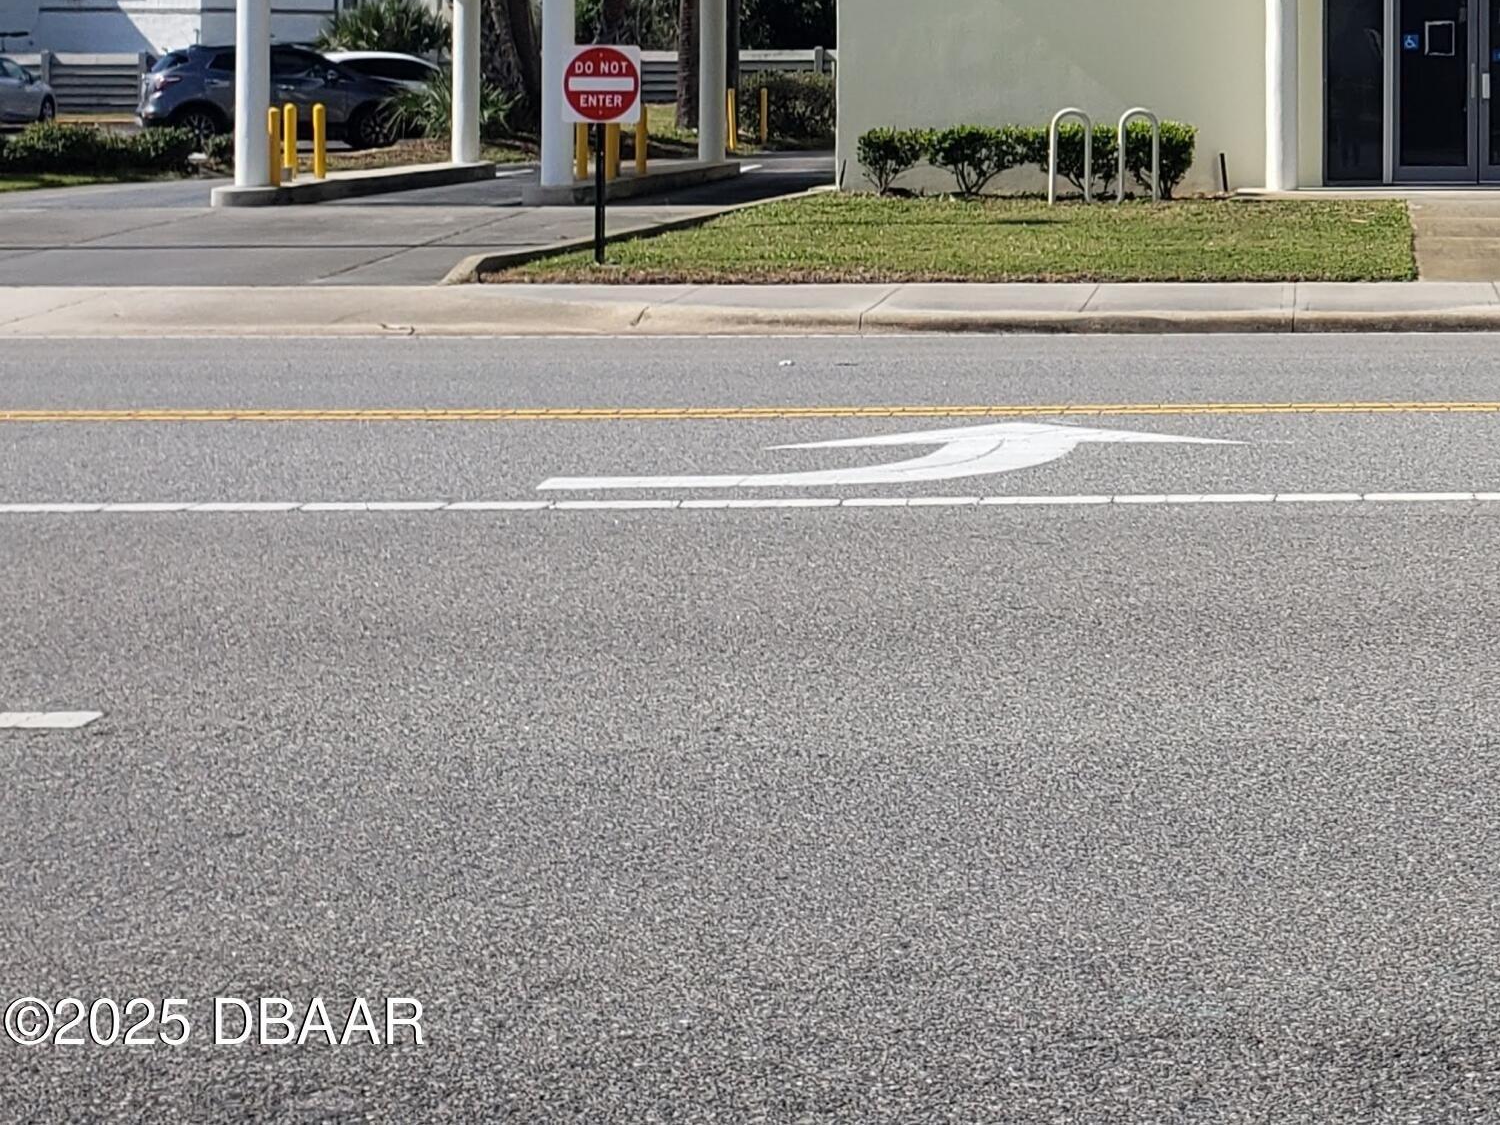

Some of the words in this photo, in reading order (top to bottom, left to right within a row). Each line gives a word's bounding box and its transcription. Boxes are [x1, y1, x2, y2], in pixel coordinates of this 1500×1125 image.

[575, 61, 594, 74] DO
[600, 61, 628, 74] NOT
[580, 94, 623, 107] ENTER
